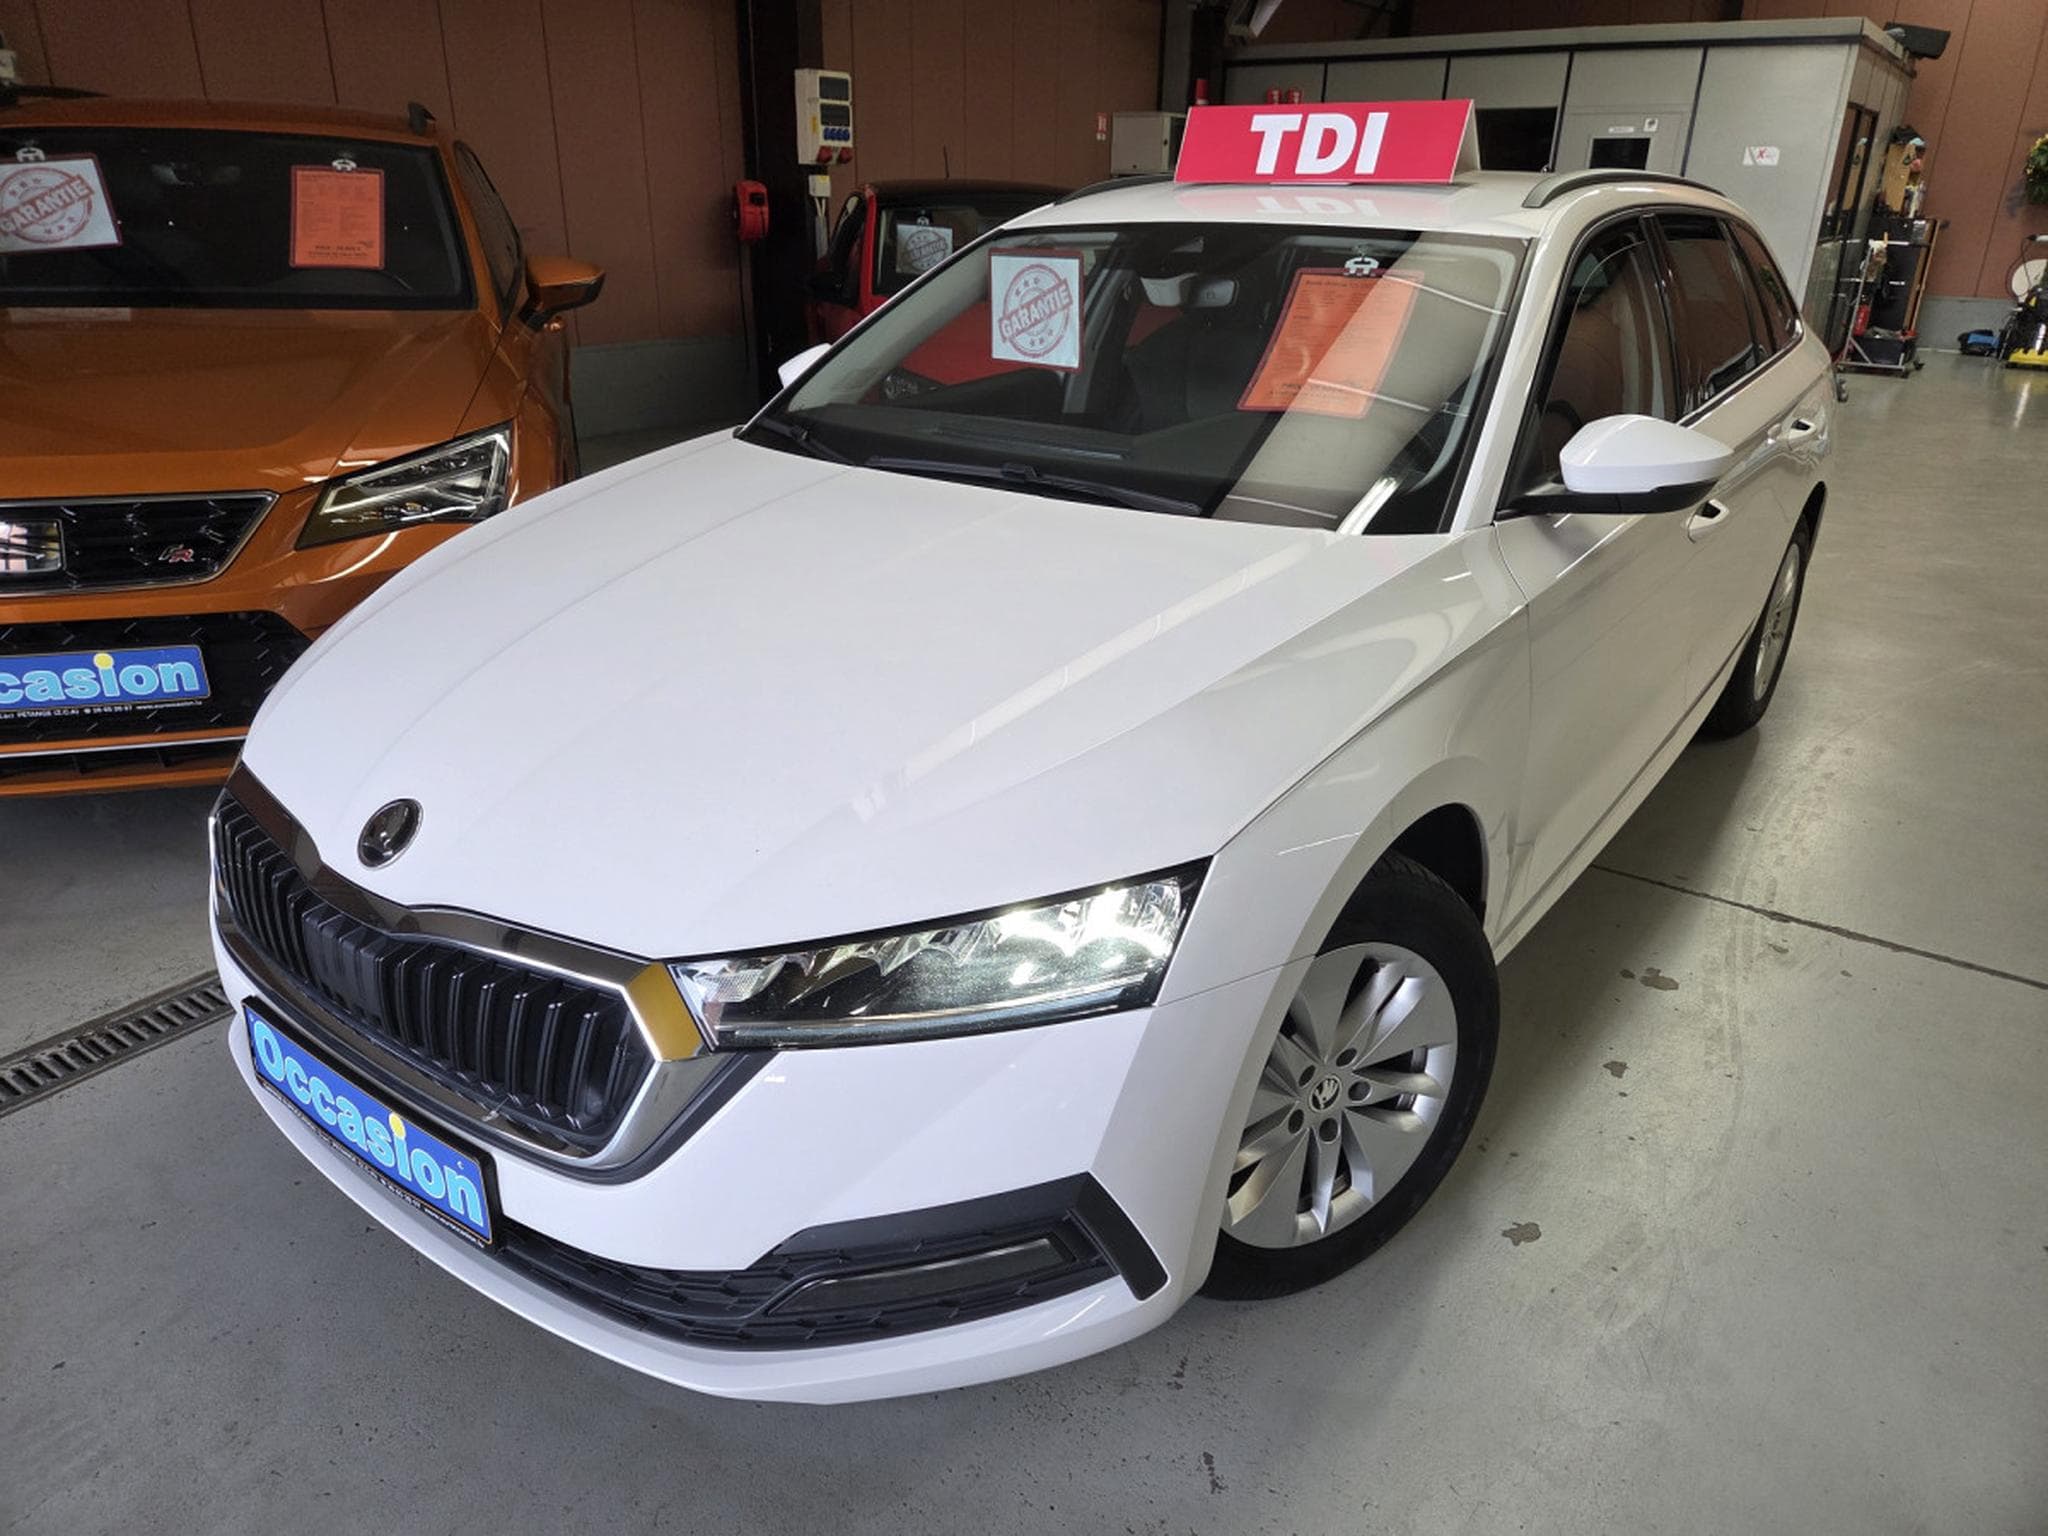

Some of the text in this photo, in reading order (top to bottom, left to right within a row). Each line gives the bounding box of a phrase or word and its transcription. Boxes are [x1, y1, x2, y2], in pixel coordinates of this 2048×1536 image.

[1251, 112, 1389, 174] TDI
[0, 180, 88, 232] GARANTIE
[1001, 283, 1069, 336] GARANTIE
[254, 1020, 484, 1228] Occasion
